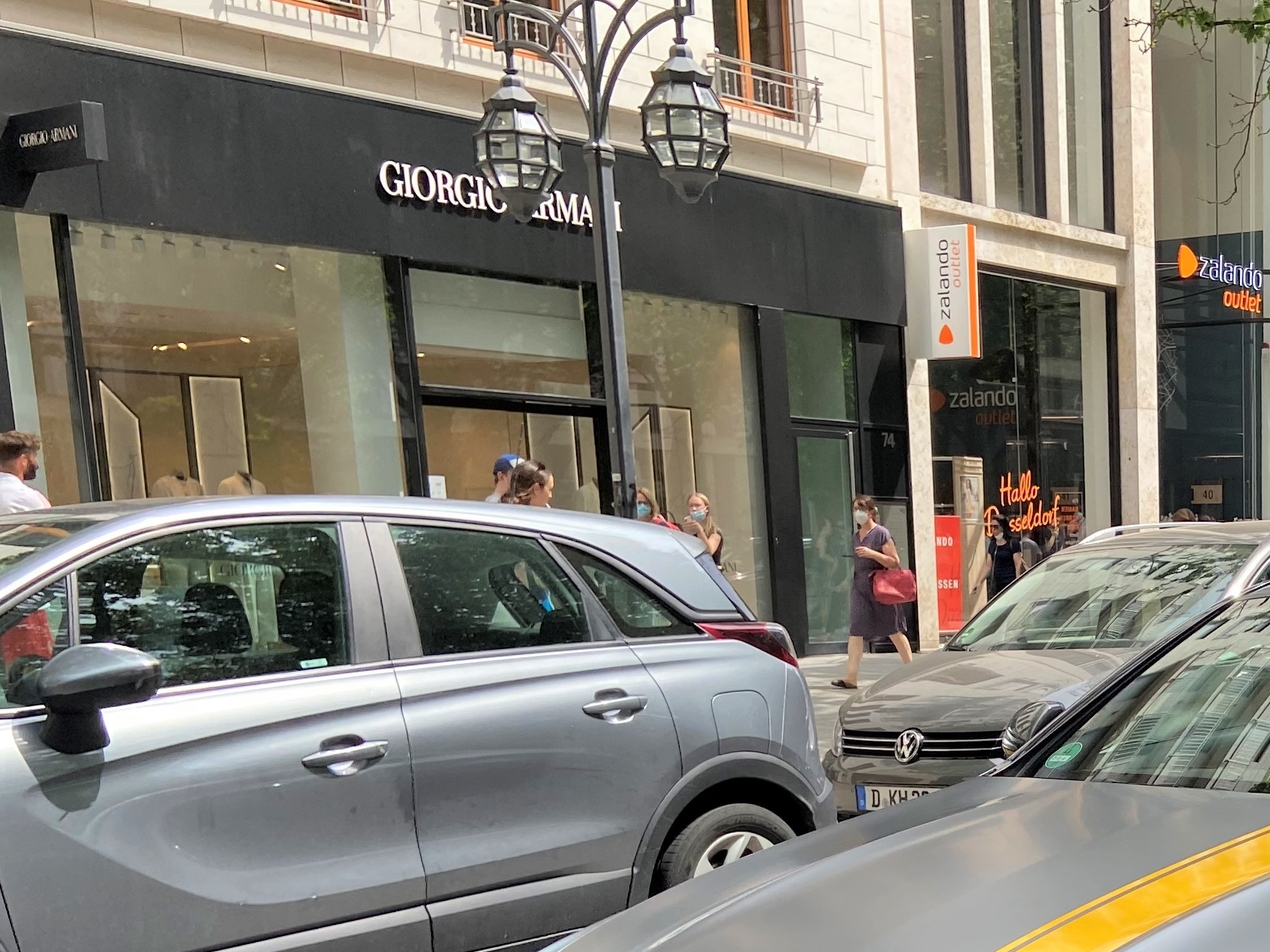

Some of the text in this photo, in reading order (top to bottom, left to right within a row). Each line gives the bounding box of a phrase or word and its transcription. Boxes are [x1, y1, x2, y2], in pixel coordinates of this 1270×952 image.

[950, 240, 962, 288] outlet
[1199, 253, 1263, 291] zalando
[936, 239, 951, 320] zalando
[1222, 290, 1262, 313] outlet
[949, 385, 1017, 408] zalando
[975, 409, 1016, 425] outlet
[881, 432, 896, 448] 74
[999, 469, 1040, 507] Hallo
[1202, 489, 1214, 500] 40
[983, 494, 1061, 538] Dsseldorf
[871, 788, 881, 808] D
